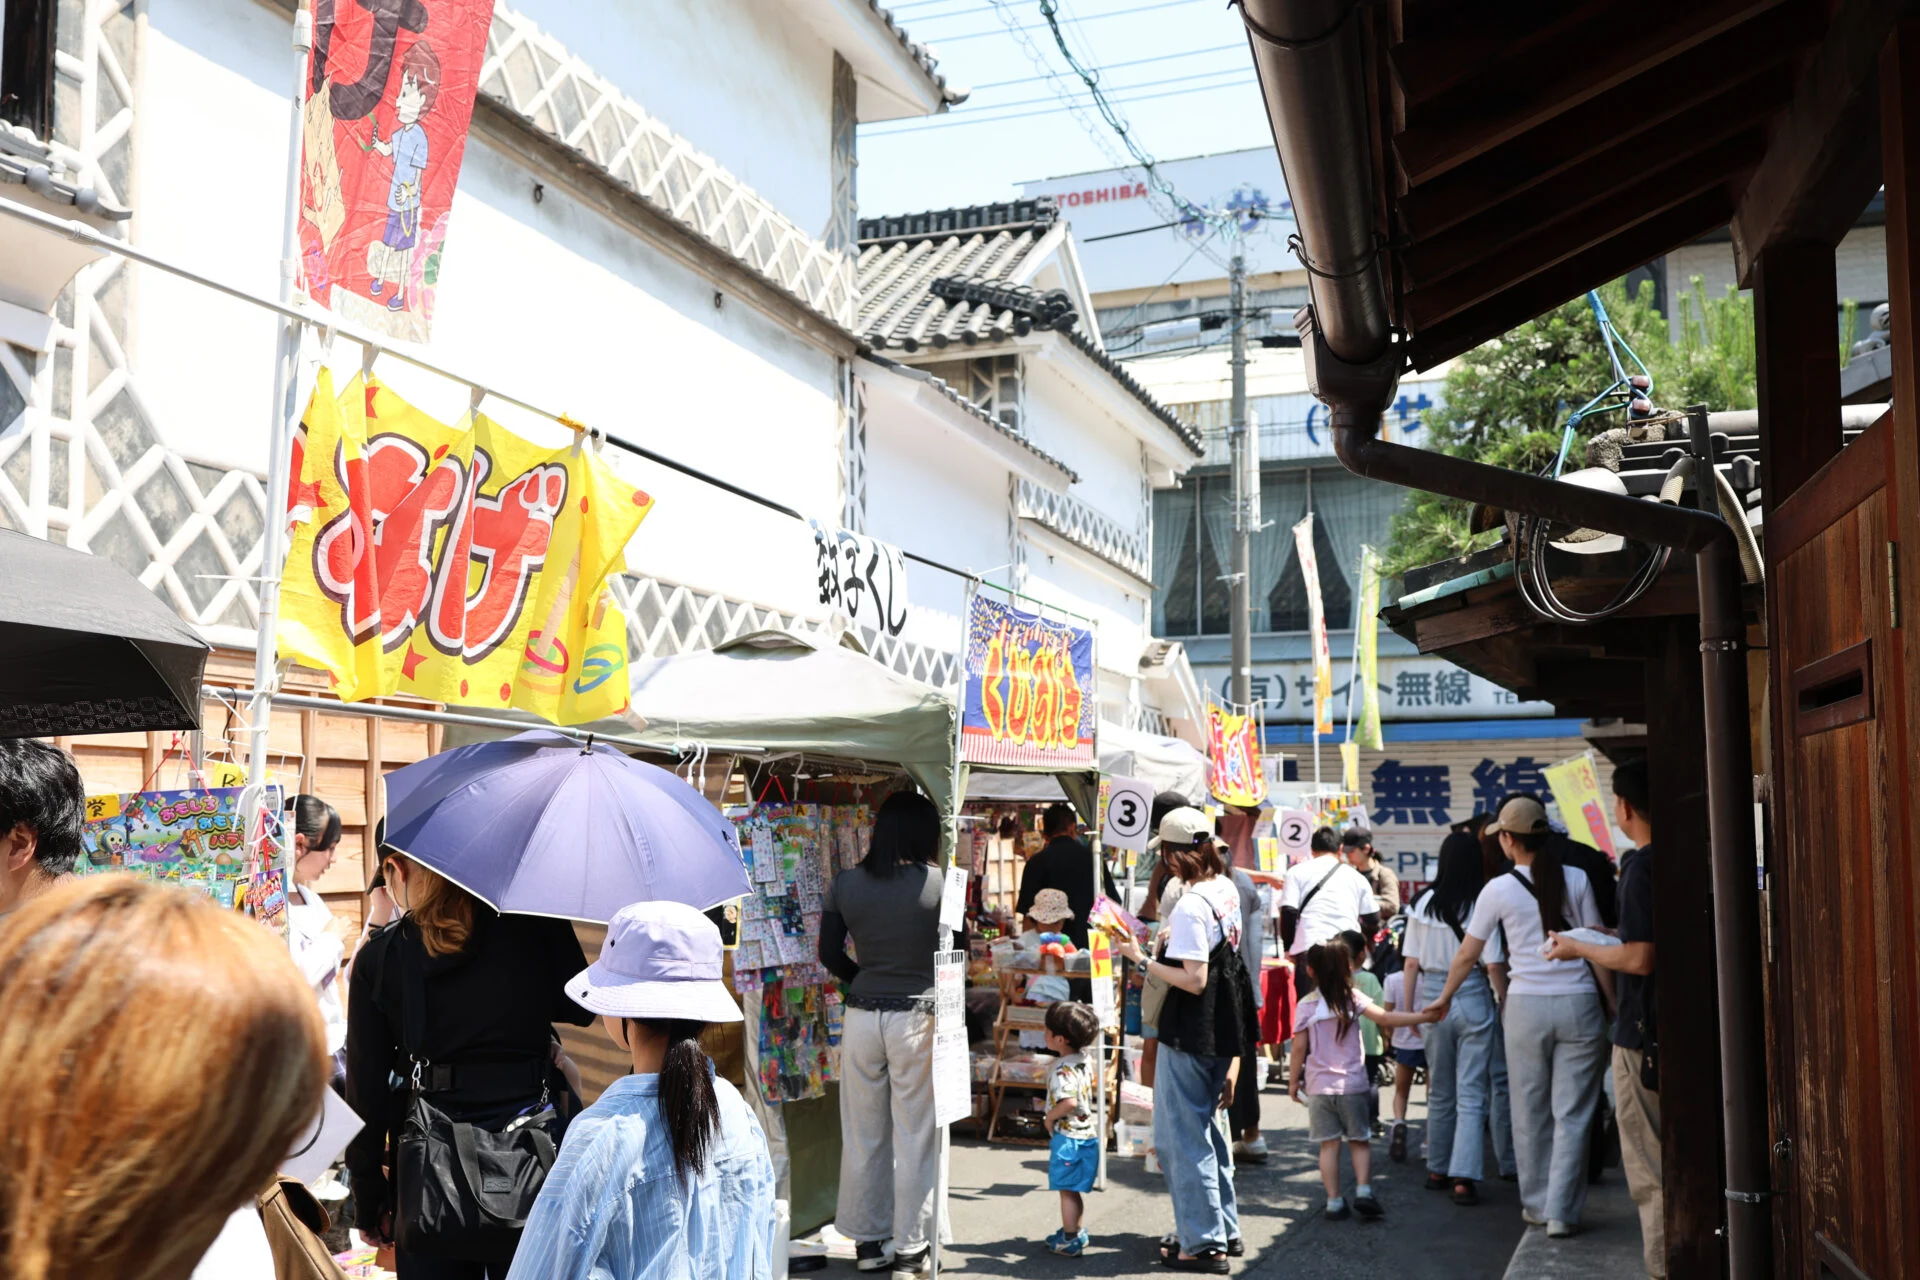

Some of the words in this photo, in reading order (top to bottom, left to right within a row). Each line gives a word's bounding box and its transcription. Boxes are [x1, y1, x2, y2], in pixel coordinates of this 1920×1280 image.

[1056, 183, 1148, 209] TOSHIBA
[1117, 799, 1138, 828] 3
[1289, 823, 1302, 842] 2
